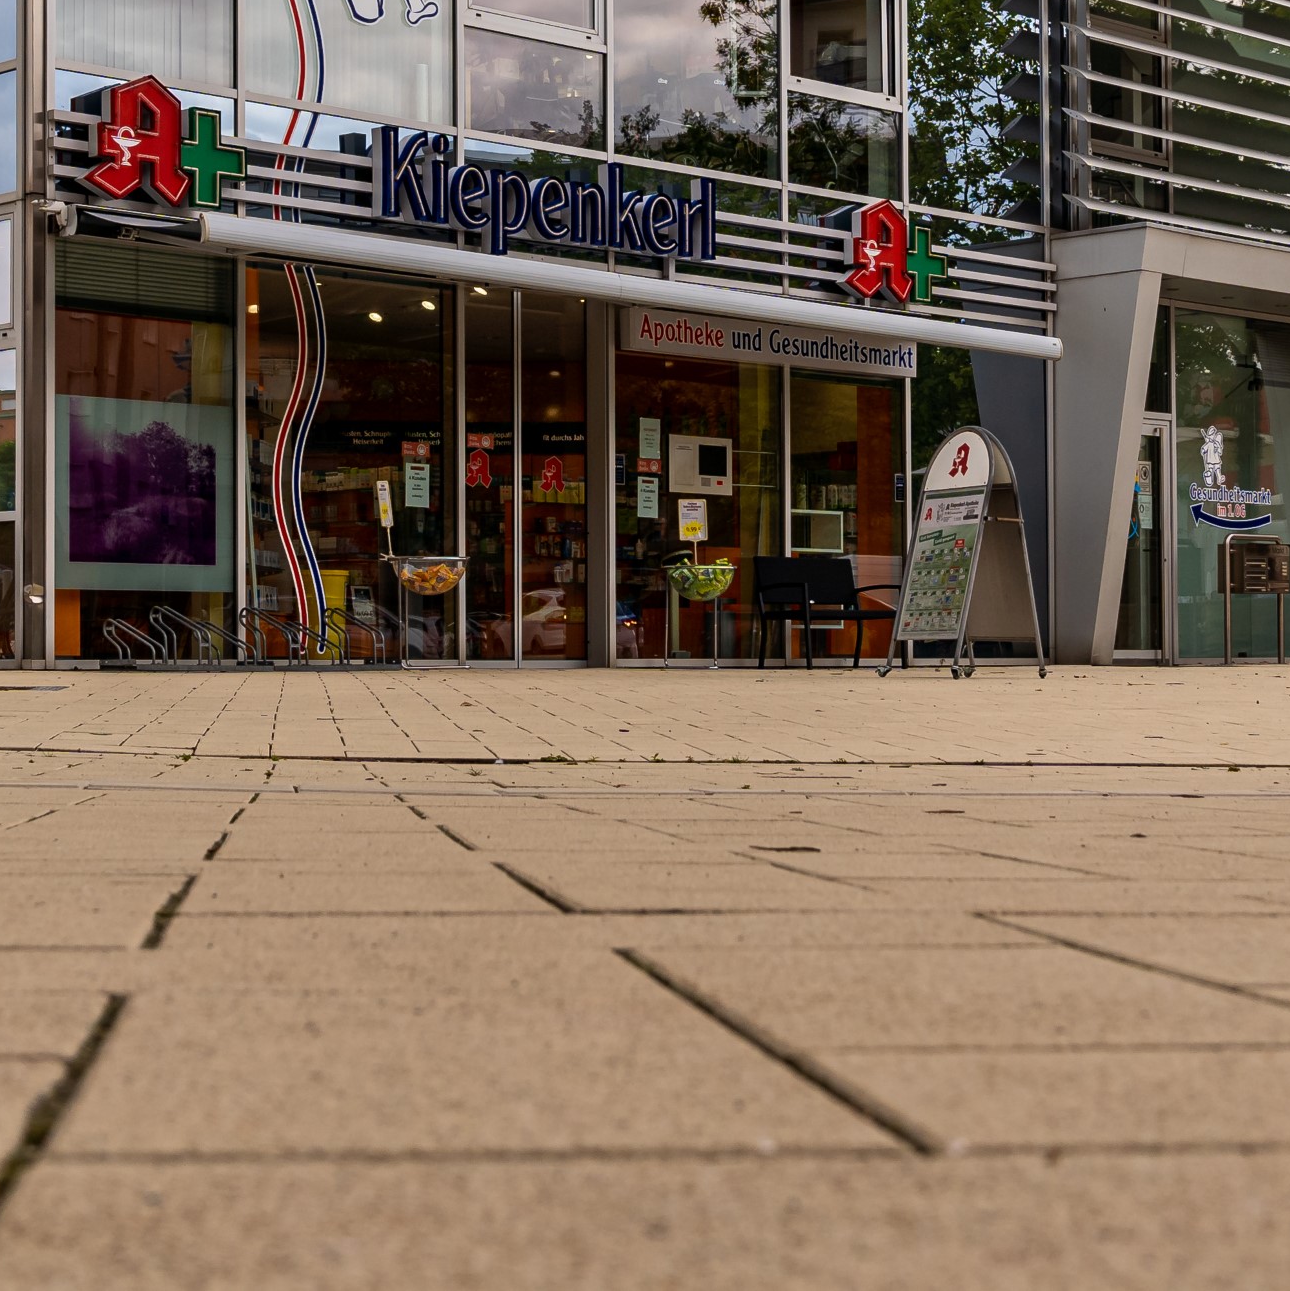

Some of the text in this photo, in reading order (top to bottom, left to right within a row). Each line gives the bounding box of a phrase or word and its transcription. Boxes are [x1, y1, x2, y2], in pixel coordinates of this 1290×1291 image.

[373, 125, 717, 261] Kiepenkerl
[639, 312, 914, 369] Apotheke und Gesundheitsmarkt
[1189, 483, 1272, 505] Gesundheitsmarkt
[1217, 503, 1247, 518] im 1. OG
